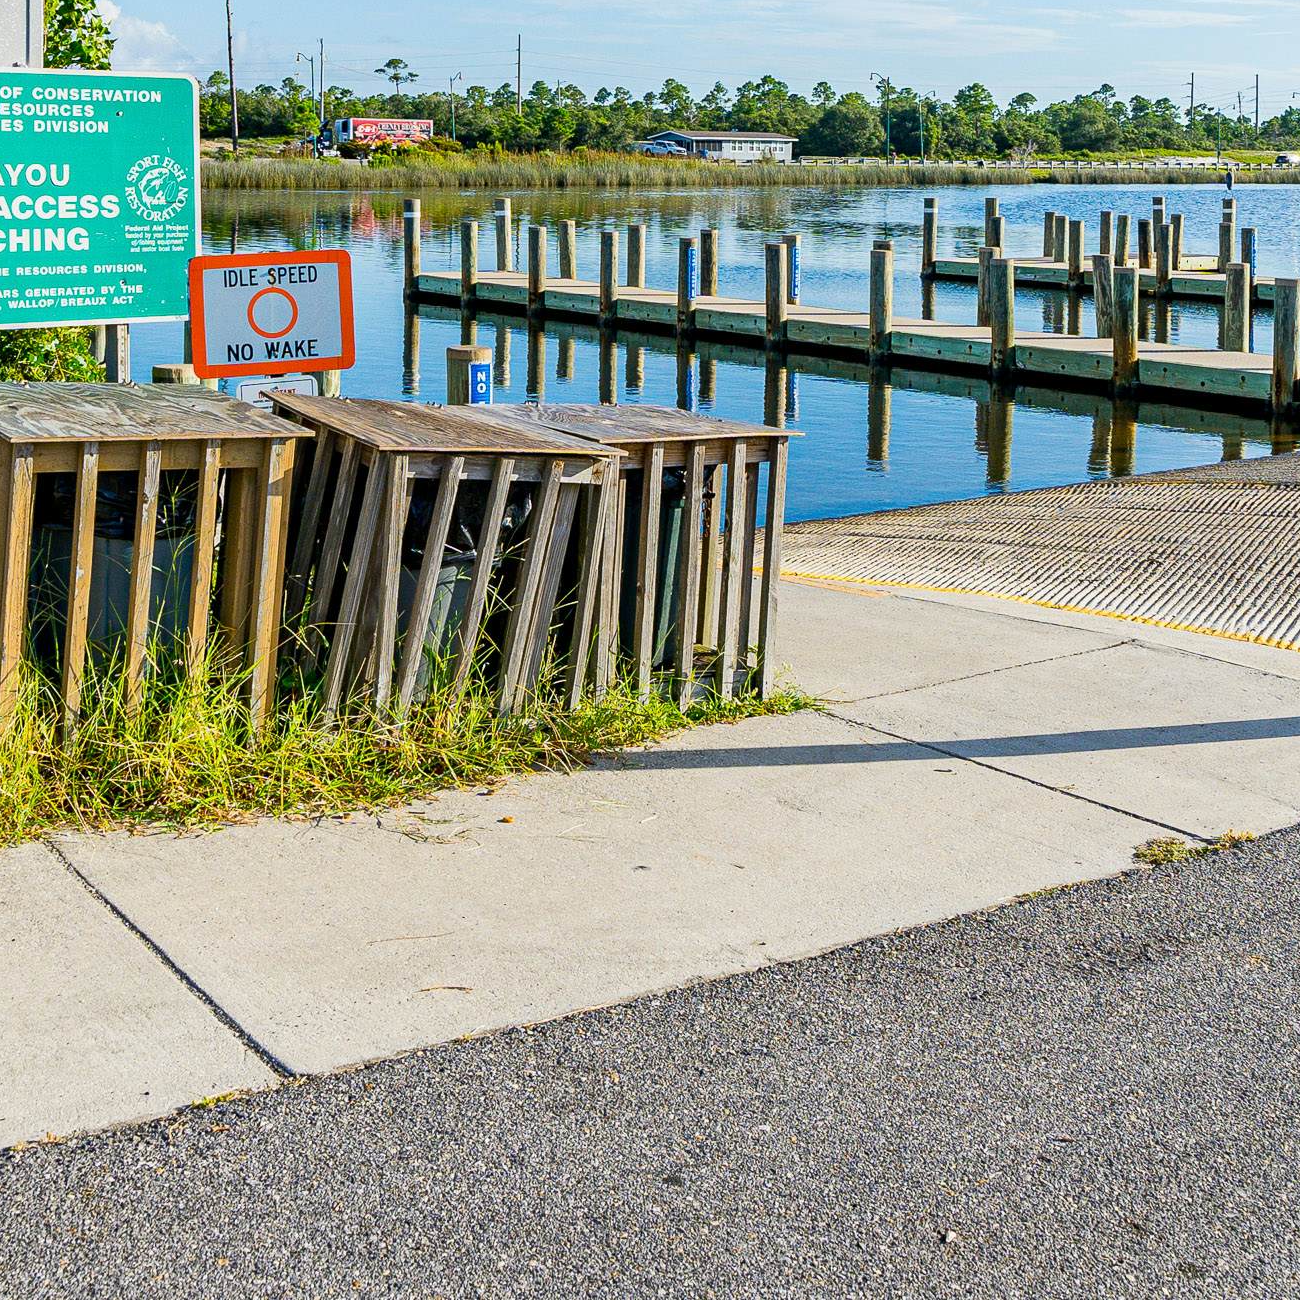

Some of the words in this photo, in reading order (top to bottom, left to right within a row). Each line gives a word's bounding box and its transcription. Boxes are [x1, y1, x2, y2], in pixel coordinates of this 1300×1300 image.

[0, 85, 22, 99] OF
[31, 87, 161, 102] CONSERVATION
[33, 119, 108, 133] DIVISION
[127, 155, 160, 183] SPORT
[162, 156, 187, 182] FISH
[125, 186, 188, 222] RESTORATION
[16, 265, 87, 275] RESOURCES
[93, 264, 146, 273] DIVISION,
[223, 268, 258, 288] IDLE
[267, 265, 318, 285] SPEED
[25, 286, 94, 297] GENERATED
[101, 285, 115, 294] BY
[121, 285, 143, 294] THE
[8, 298, 107, 309] WALLOP/BREAUX
[113, 295, 134, 305] ACT
[227, 343, 254, 362] NO
[265, 339, 319, 359] WAKE
[477, 371, 487, 394] NO
